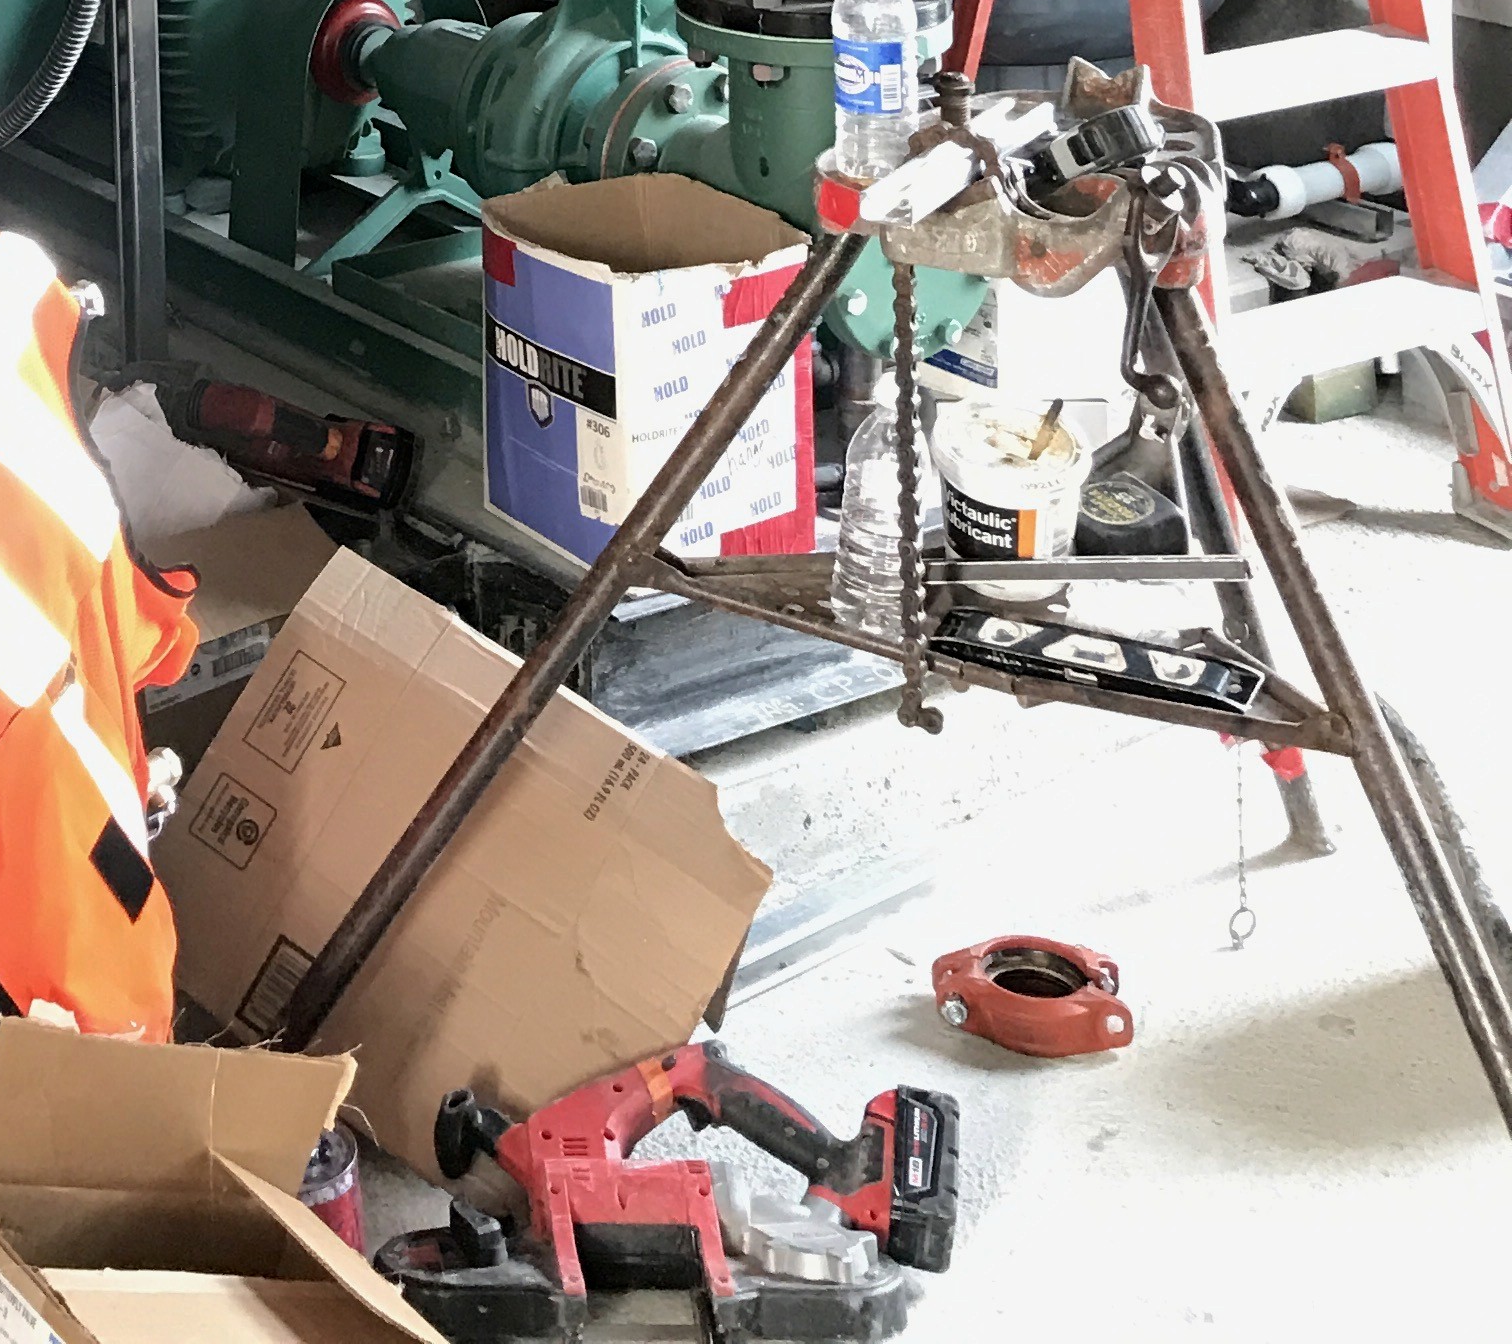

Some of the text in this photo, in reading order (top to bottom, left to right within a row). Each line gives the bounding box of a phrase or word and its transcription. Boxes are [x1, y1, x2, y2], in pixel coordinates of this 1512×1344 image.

[494, 325, 587, 400] HOLDRITE
[586, 417, 611, 439] #306
[948, 490, 1012, 531] ictaulic
[948, 510, 1013, 549] ubricant
